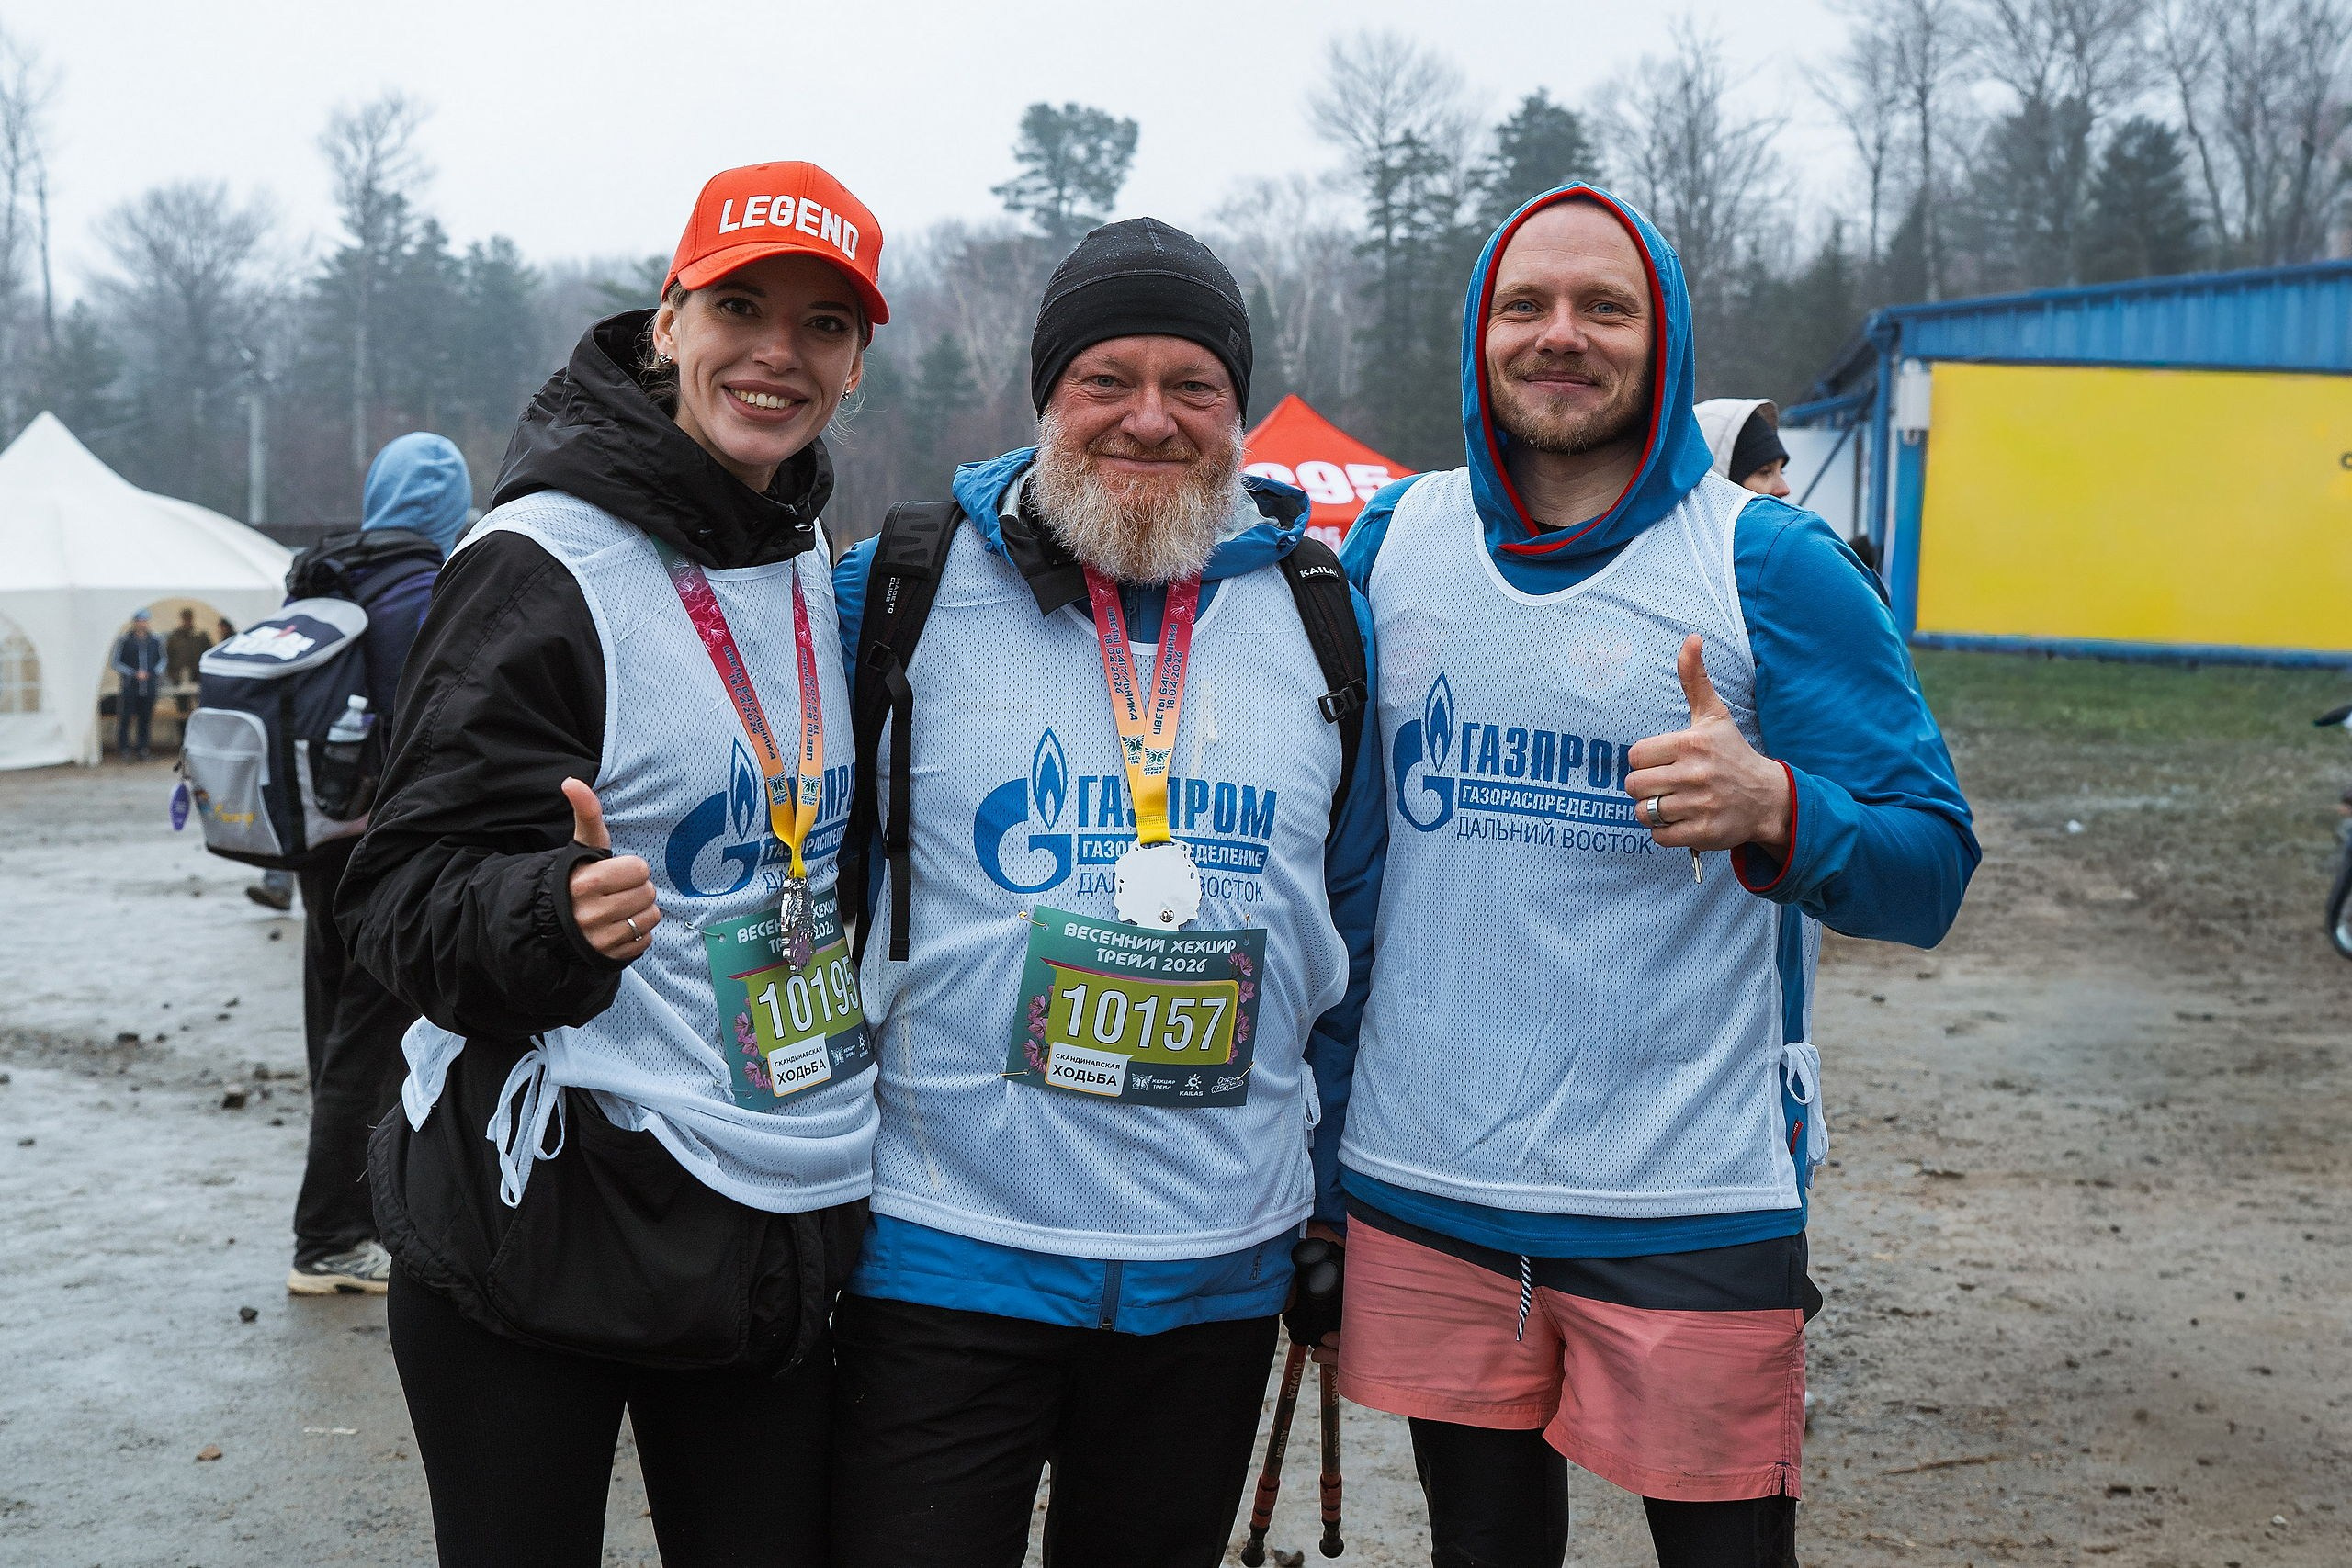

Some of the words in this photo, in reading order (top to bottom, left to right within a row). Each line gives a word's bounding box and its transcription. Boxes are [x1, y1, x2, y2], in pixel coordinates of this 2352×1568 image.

[719, 195, 859, 260] LEGEND
[888, 603, 895, 614] TO
[1103, 634, 1124, 694] 18.04.2026
[1106, 606, 1121, 643] ЦВЕТЫ
[1115, 648, 1138, 721] БАГУЛЬНИКА
[1159, 624, 1178, 694] БАГУЛЬНИКА
[1166, 650, 1183, 709] 18.04.2026
[723, 645, 745, 682] ЦВЕТЫ
[742, 686, 776, 760] БАГУЛЬНИКА
[729, 674, 760, 734] 18.04.2026
[1153, 699, 1166, 735] ЦВЕТЫ
[1078, 775, 1277, 840] ГАПРОМ
[1462, 785, 1639, 822] ГАЗОРАСПРЕДЕЛЕНИ
[1457, 815, 1555, 846] ДАЛЬНИЙ
[1562, 829, 1653, 855] ВОСТОК
[1064, 922, 1166, 953] ВЕСЕННИЙ
[1170, 939, 1237, 954] ХЕХЦИР
[1096, 948, 1156, 970] ТРЕЙЛ
[1162, 958, 1208, 973] 2026
[758, 954, 860, 1040] 10195
[1061, 983, 1227, 1055] 10157
[775, 1045, 823, 1067] СКАНДИНАВСКАЯ
[776, 1059, 827, 1086] ХОДЬБА
[1053, 1064, 1117, 1087] ХОДЬБА
[1056, 1053, 1121, 1070] СКАНДИНАВСКАЯ
